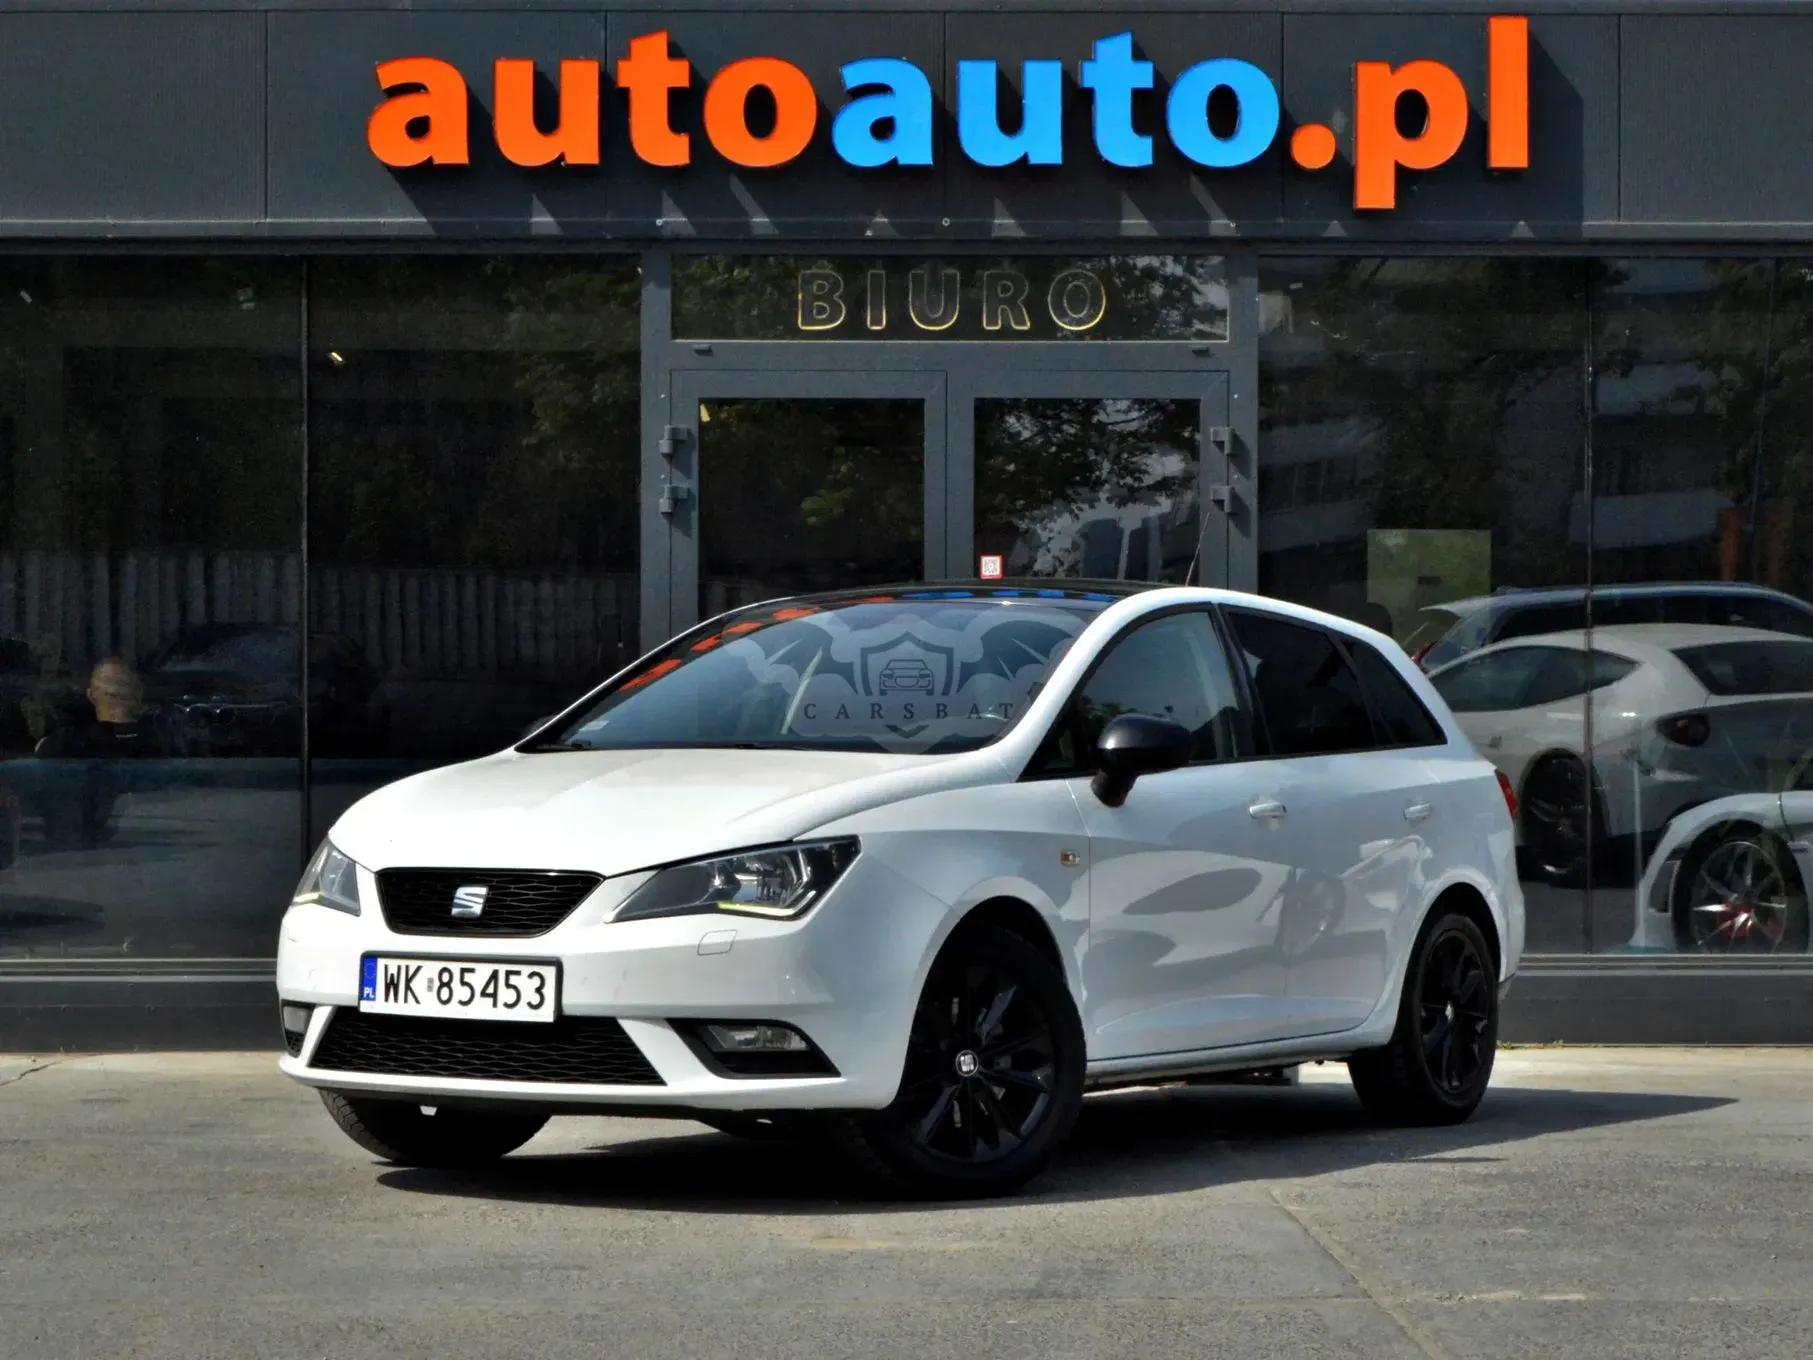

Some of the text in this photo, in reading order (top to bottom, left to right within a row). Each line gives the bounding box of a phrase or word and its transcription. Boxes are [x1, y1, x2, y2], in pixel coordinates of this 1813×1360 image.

[367, 15, 1529, 210] autoauto.pl
[797, 269, 1107, 331] BIURO
[363, 986, 375, 999] PL
[384, 964, 546, 1010] WK 85453
